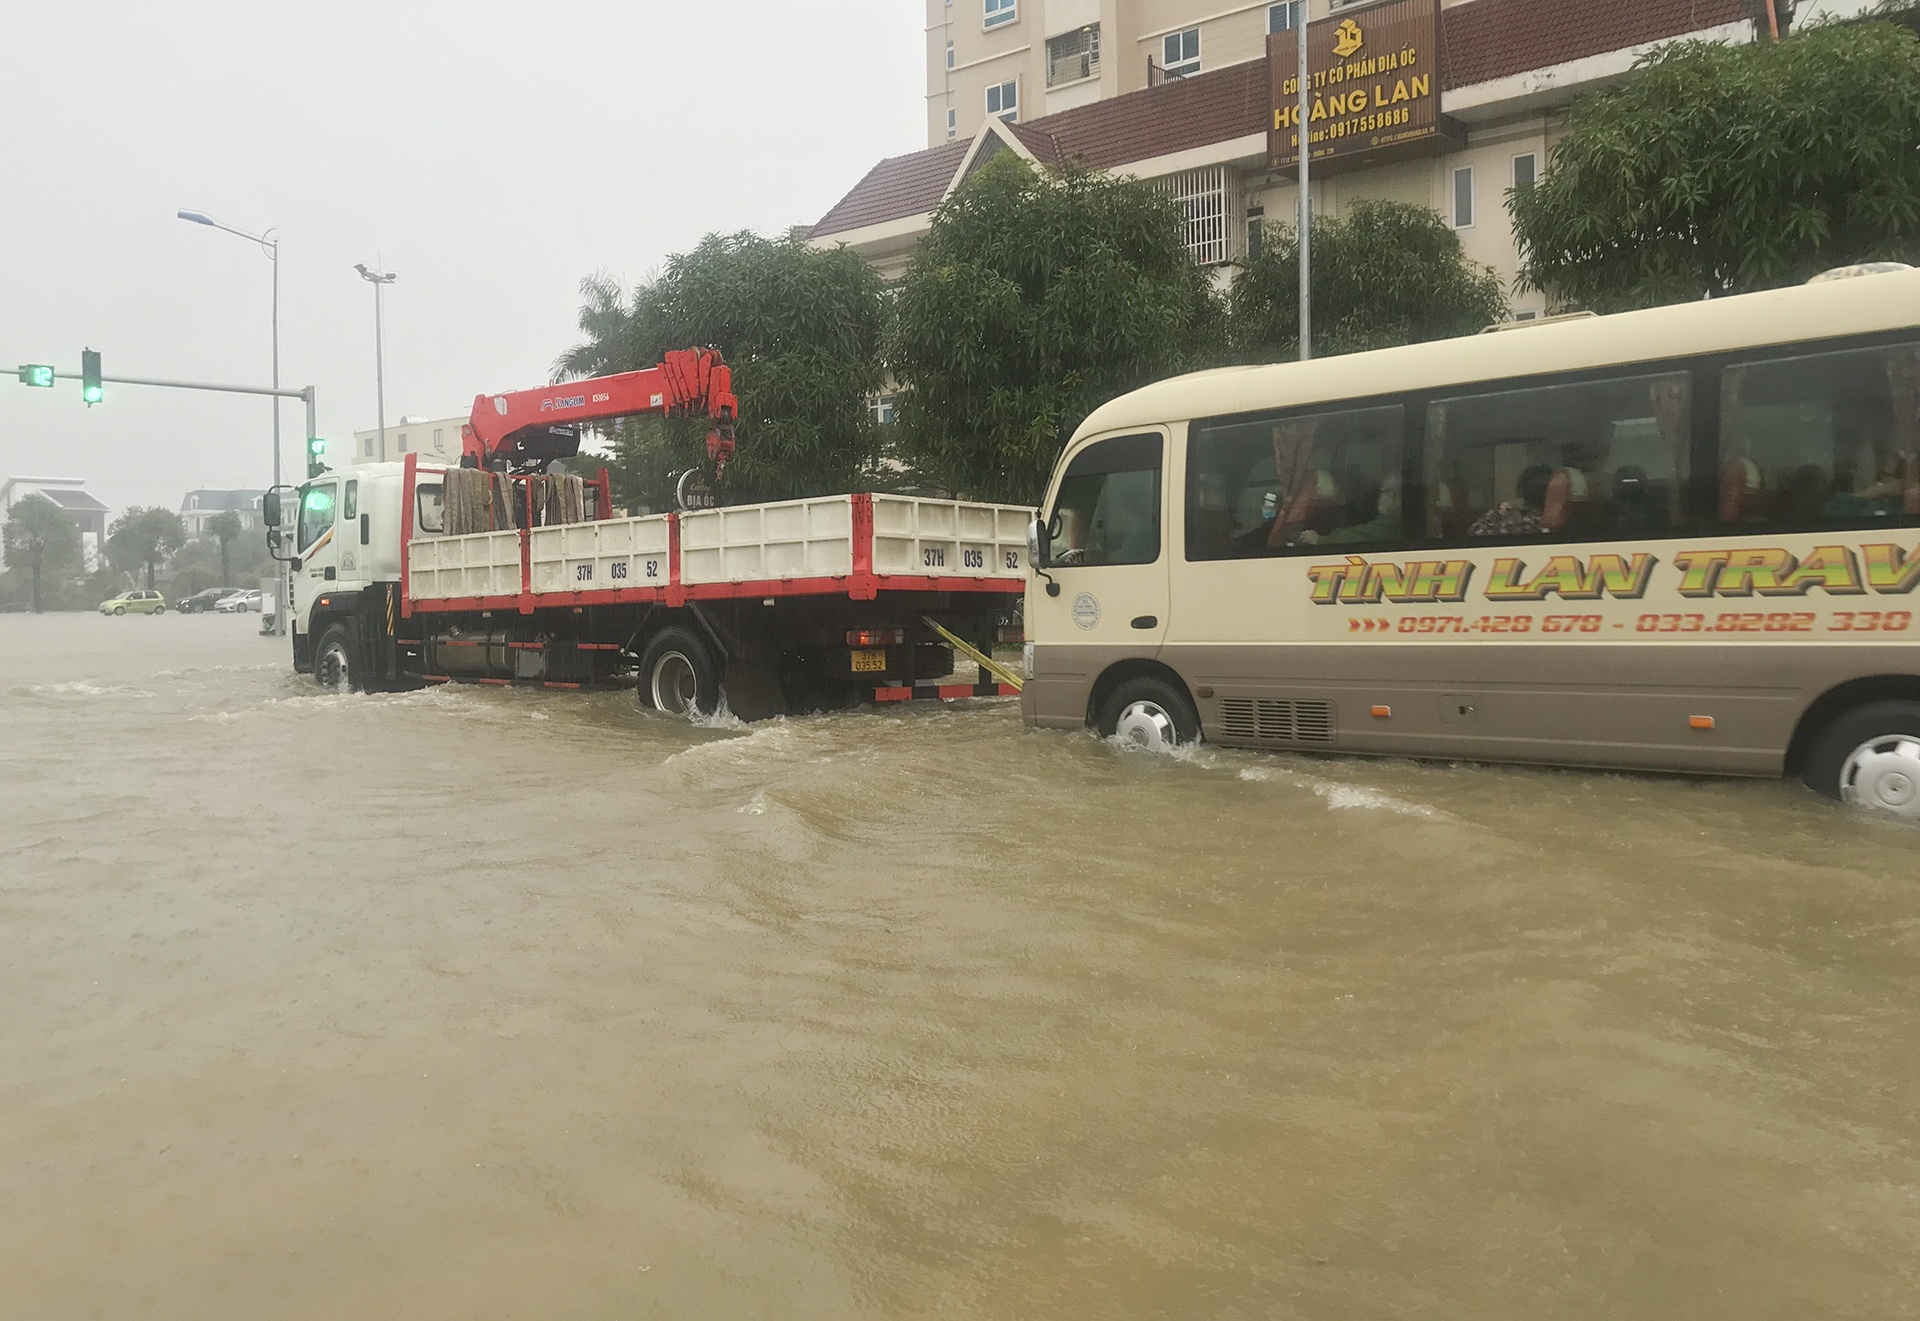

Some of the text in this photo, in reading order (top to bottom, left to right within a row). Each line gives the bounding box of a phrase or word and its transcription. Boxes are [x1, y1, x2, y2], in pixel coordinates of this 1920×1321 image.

[1314, 70, 1327, 88] TY
[1378, 53, 1398, 75] ĐỊA
[1400, 42, 1416, 67] ỐC
[1273, 73, 1429, 130] HOÀNG LAN
[34, 367, 52, 386] 12
[924, 548, 1018, 569] 37H 035 52
[577, 560, 658, 581] 37H 035 52
[1306, 555, 1476, 605] TÌNH
[1483, 550, 1660, 601] LAN
[1397, 614, 1533, 633] 0971.428
[1541, 614, 1603, 633] 678
[1635, 612, 1816, 632] 033.8282
[1826, 610, 1912, 631] 330
[855, 661, 883, 671] 035.52
